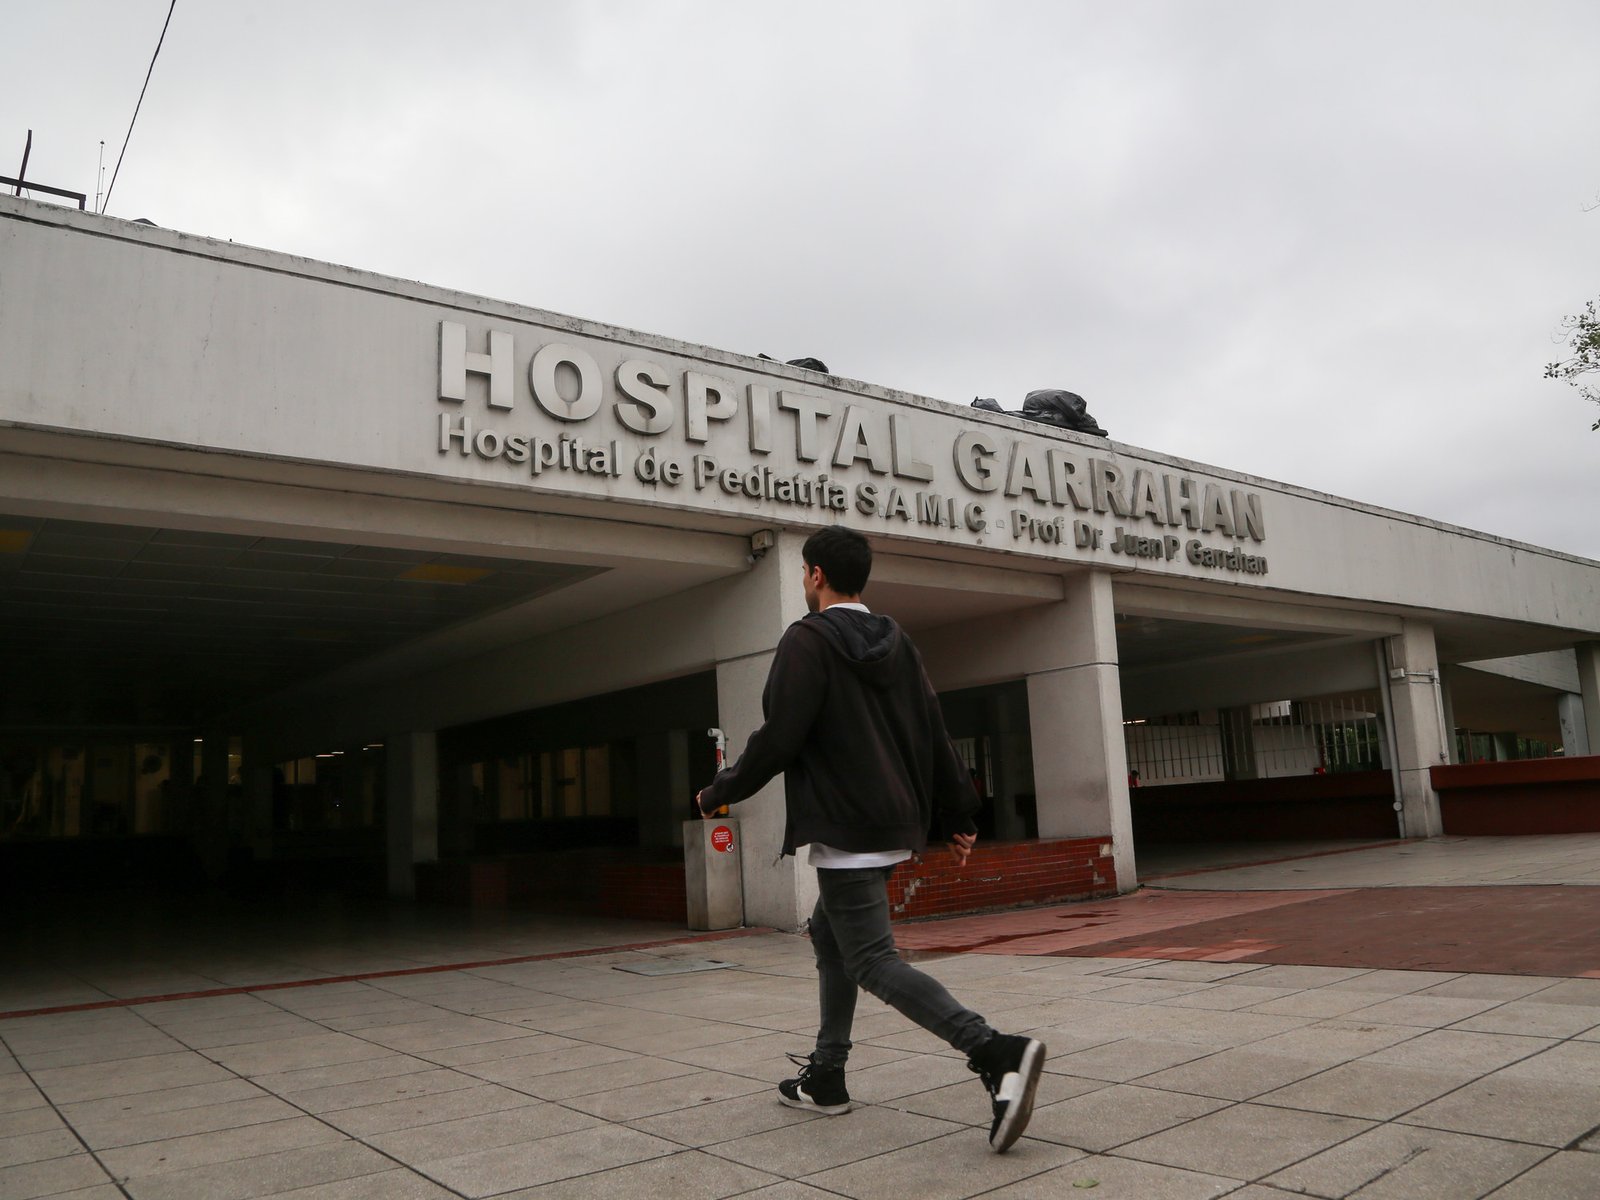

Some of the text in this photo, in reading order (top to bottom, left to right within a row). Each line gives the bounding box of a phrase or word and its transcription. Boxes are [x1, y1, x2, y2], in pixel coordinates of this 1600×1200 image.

[438, 320, 1265, 542] HOSPITAL GARRAHAN
[438, 413, 622, 477] Hospital
[635, 447, 684, 486] de
[694, 454, 848, 511] Pediatria
[1110, 526, 1163, 560] Juan
[1185, 538, 1268, 576] Garrahan
